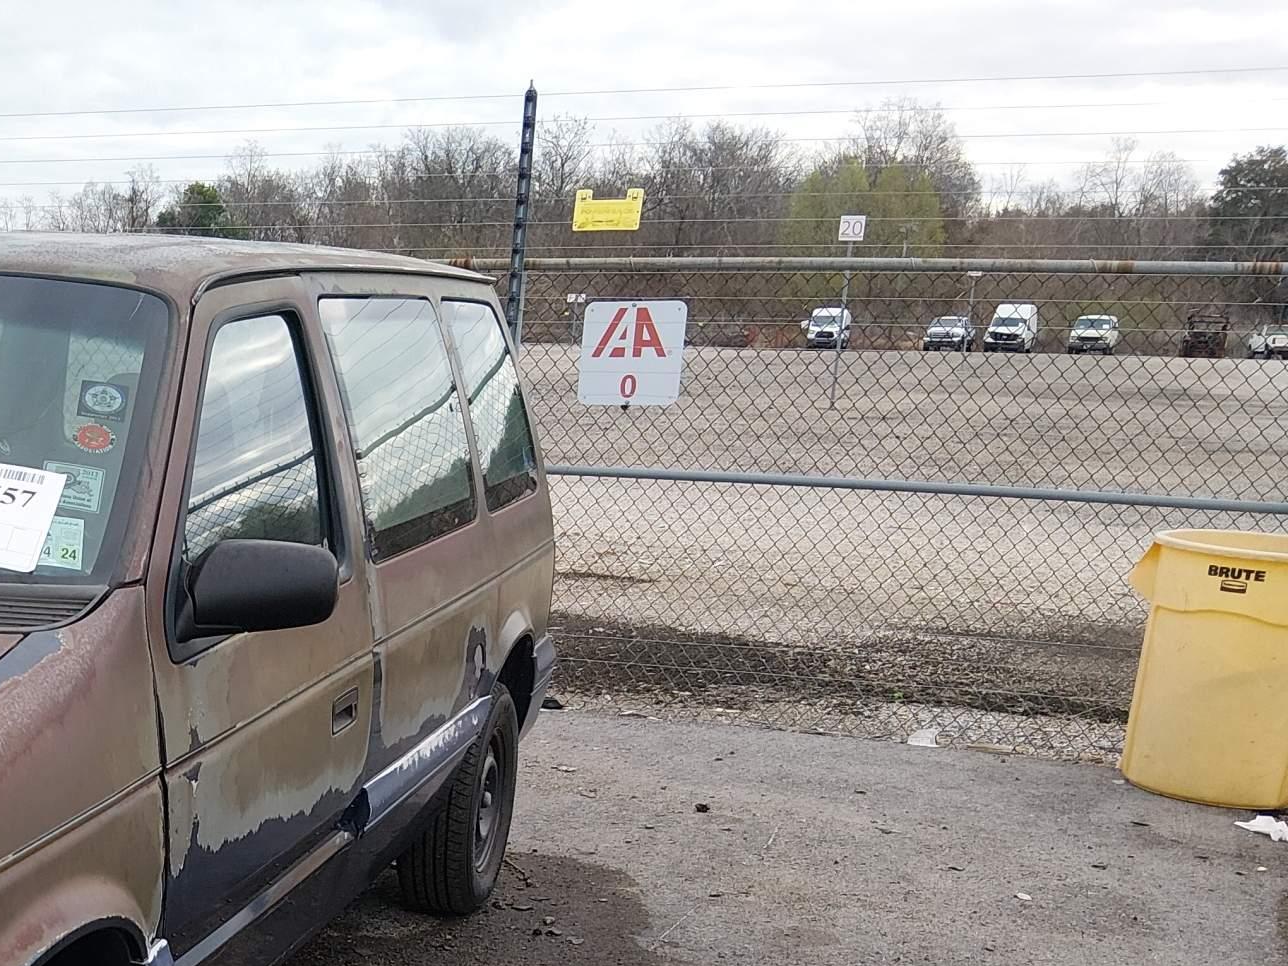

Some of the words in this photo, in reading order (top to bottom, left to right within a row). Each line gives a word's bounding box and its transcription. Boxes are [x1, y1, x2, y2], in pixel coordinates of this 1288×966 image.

[840, 220, 863, 236] 20
[60, 547, 77, 561] 24
[1207, 564, 1266, 582] BRUTE
